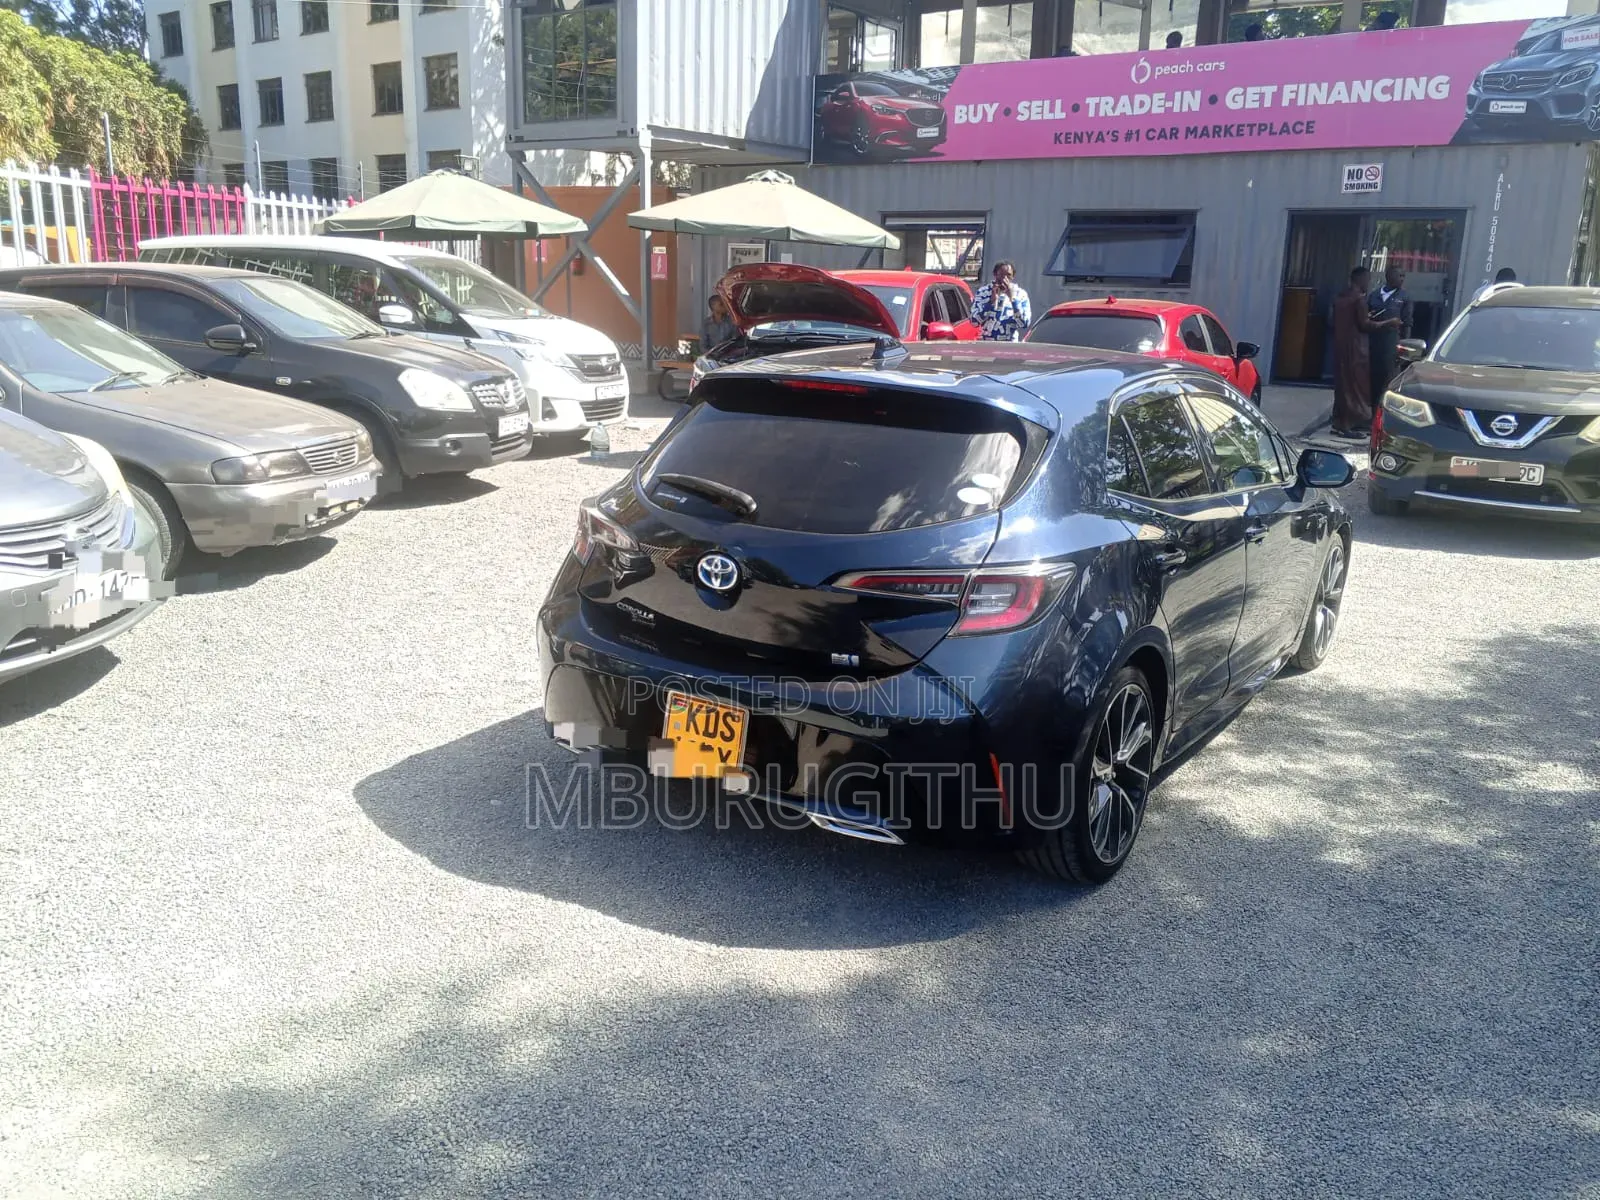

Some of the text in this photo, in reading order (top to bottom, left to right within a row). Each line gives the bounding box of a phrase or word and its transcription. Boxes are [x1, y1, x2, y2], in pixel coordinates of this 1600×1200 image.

[1154, 60, 1226, 80] peach cars
[954, 74, 1451, 125] BUY SELL TRADE-IN GET FINANCING
[1053, 119, 1317, 146] KENYA'S #1 CAR MARKETPLACE
[1344, 181, 1379, 191] SMOKING
[1347, 168, 1364, 181] NO
[685, 702, 740, 743] KDS
